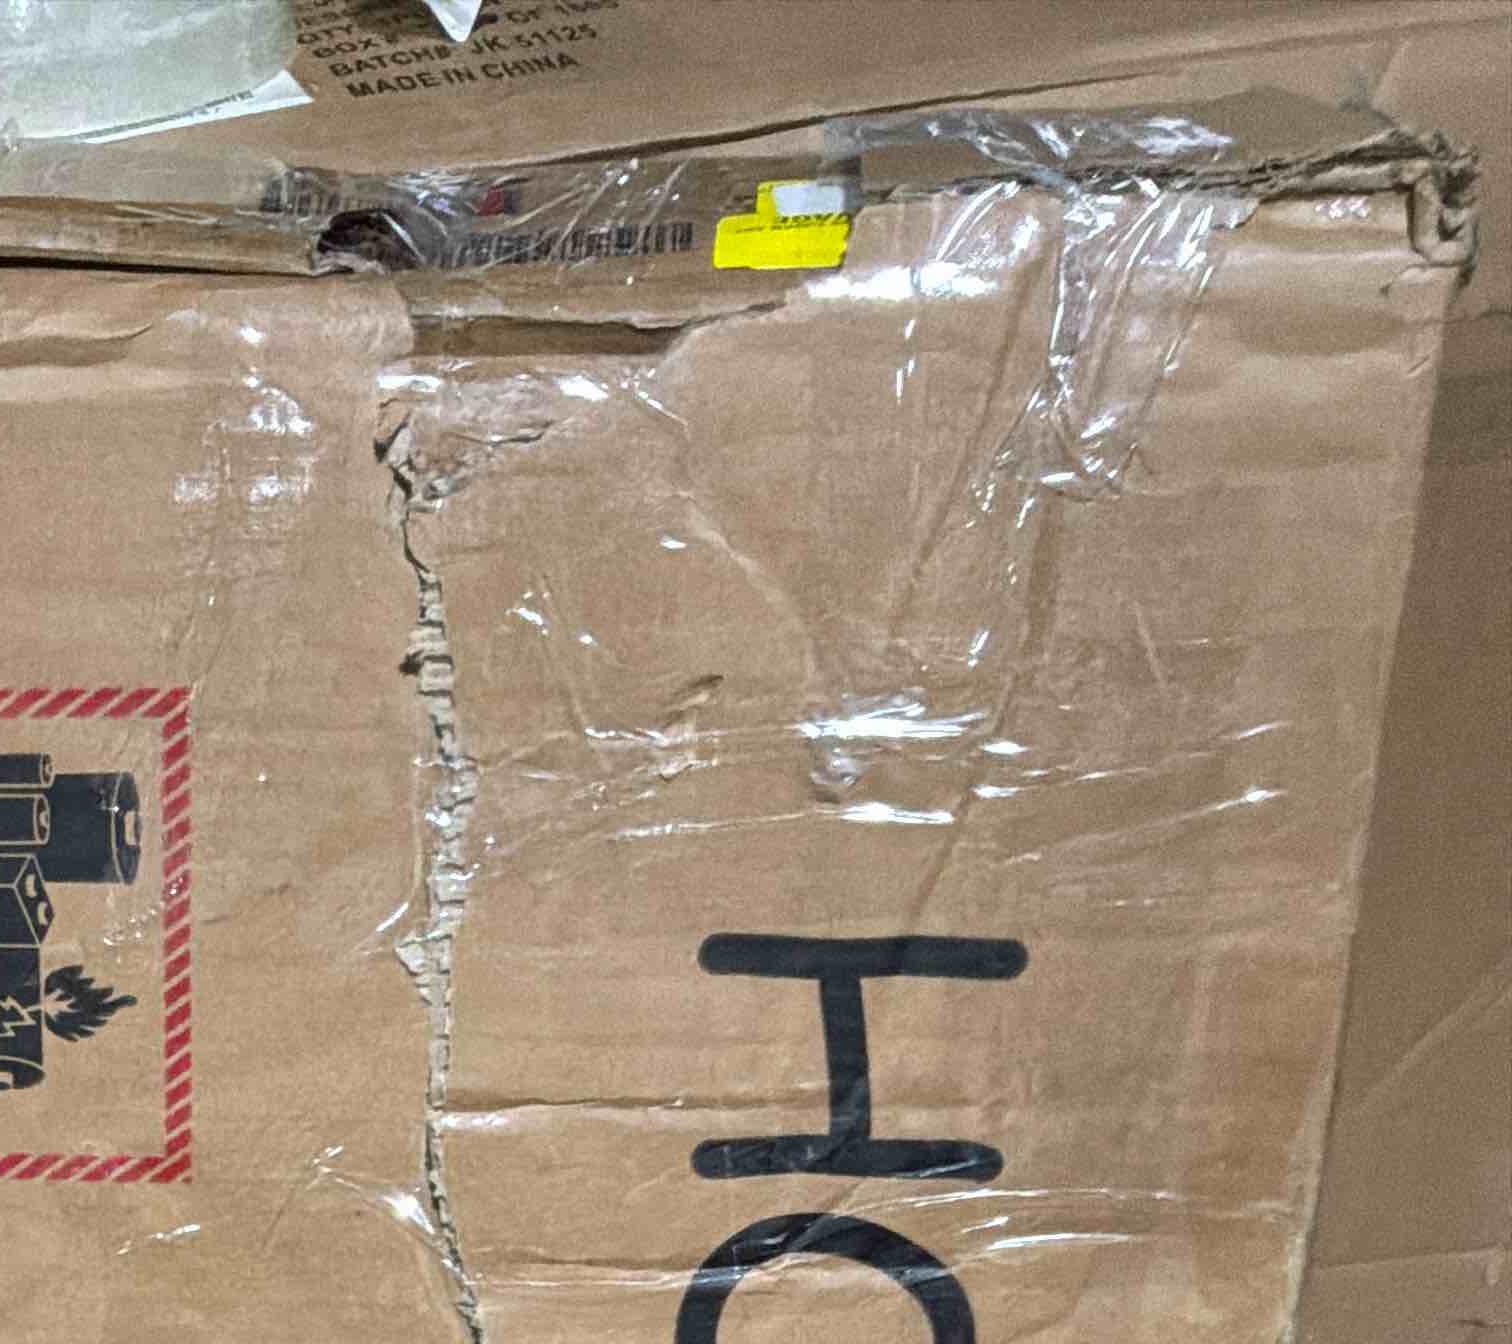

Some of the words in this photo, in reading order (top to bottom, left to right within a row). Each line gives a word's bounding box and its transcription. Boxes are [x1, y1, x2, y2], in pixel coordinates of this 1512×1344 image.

[346, 70, 436, 98] MADE
[442, 66, 477, 84] IN
[482, 52, 581, 80] CHINA
